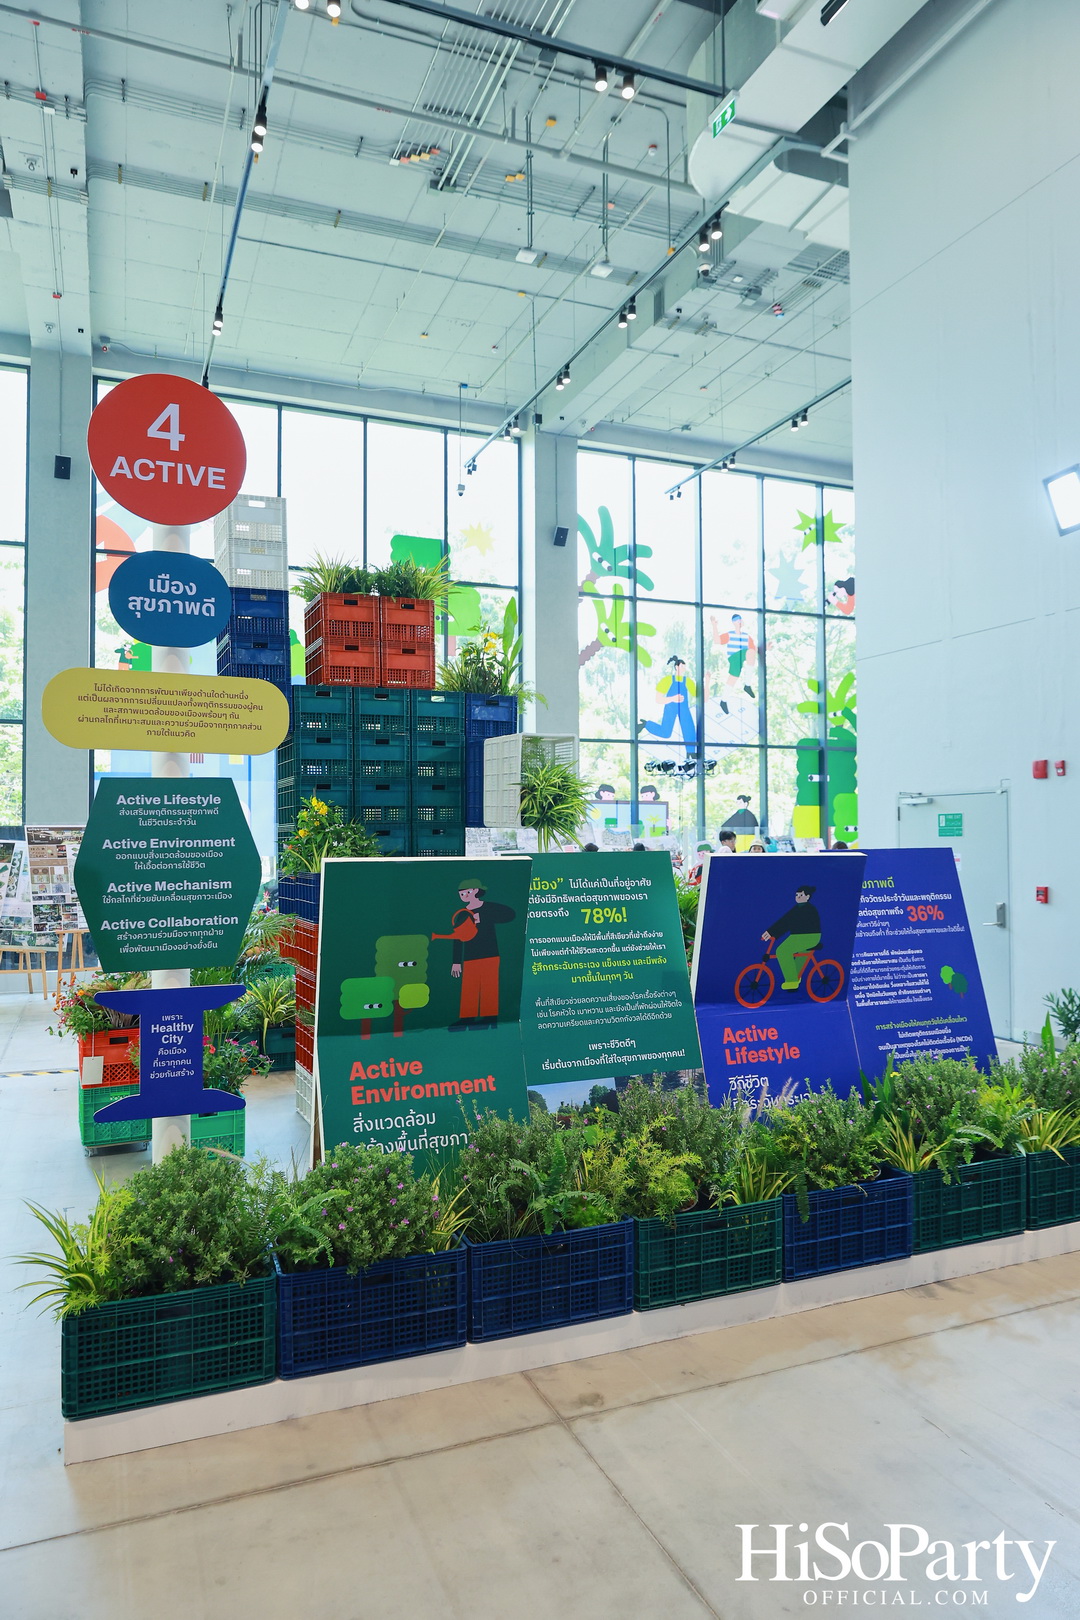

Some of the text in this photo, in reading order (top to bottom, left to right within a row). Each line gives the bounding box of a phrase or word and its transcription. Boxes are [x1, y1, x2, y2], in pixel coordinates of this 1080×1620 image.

[147, 402, 186, 452] 4
[109, 456, 226, 490] ACTIVE
[148, 573, 197, 596] เมือง
[128, 594, 216, 619] สุขภาพดี
[94, 683, 249, 700] ไม่ได้เกิดจากการพัฒนาเพียงด้านใดด้านหนึ่ง
[78, 694, 263, 712] แต่เป็นผลจากการเปลี่ยนแปลงทั้งพฤติกรรมของผู้คน
[103, 706, 240, 720] และสภาพแวดล้อมของเมืองพร้อมๆ กัน
[78, 714, 262, 732] ผ่านกลไกที่เหมาะสมและความร่วมมือจากทุกภาคส่วน
[146, 728, 196, 738] ภายใต้แนวคิด
[116, 794, 221, 807] Active Lifestyle
[119, 807, 219, 818] ส่งเสริมพฤติกรรมสุขภาพดี
[138, 817, 197, 827] ในชีวิตประจำวัน
[102, 837, 236, 849] Active Environment
[115, 849, 224, 860] ออกแบบสิ่งแวดล้อมของเมือง
[134, 860, 206, 870] ให้เอื้อต่อการใช้ชีวิต
[107, 879, 232, 893] Active Mechanism
[568, 876, 652, 890] ไม่ได้แค่เป็นที่อยู่อาศัย
[102, 891, 233, 904] ใช้กลไกที่ช่วยขับเคลื่อนสุขภาวะเมือง
[580, 906, 628, 924] 78%!
[907, 905, 945, 922] 36%
[100, 915, 239, 931] Active Collaboration
[117, 928, 224, 941] สร้างความร่วมมือจากทุกฝ่าย
[119, 941, 218, 954] เพื่อพัฒนาเมืองอย่างยั่งยืน
[531, 955, 667, 975] รู้สึกกระฉับกระเฉง แข็งแรง และมีพลัง
[571, 970, 634, 984] มากขึ้นในทุกๆ วัน
[161, 1014, 184, 1022] เพราะ
[536, 1008, 548, 1019] เช่น
[549, 1007, 576, 1018] โรคหัวใจ
[577, 1006, 604, 1016] เบาหวาน
[151, 1022, 194, 1034] Healthy
[723, 1024, 779, 1044] Active
[161, 1034, 184, 1045] City
[588, 1038, 637, 1051] เพราะชีวิตดีๆ
[157, 1047, 187, 1056] คือเมือง
[725, 1042, 801, 1065] Lifestyle
[153, 1058, 192, 1069] ที่เราทุกคน
[541, 1049, 686, 1071] เริ่มต้นจากเมืองที่ใส่ใจสุขภาพของทุกคน!
[150, 1068, 195, 1080] ช่วยกันสร้าง
[349, 1057, 423, 1081] Active
[351, 1075, 497, 1106] Environment
[353, 1108, 436, 1133] สิ่งแวดล้อม
